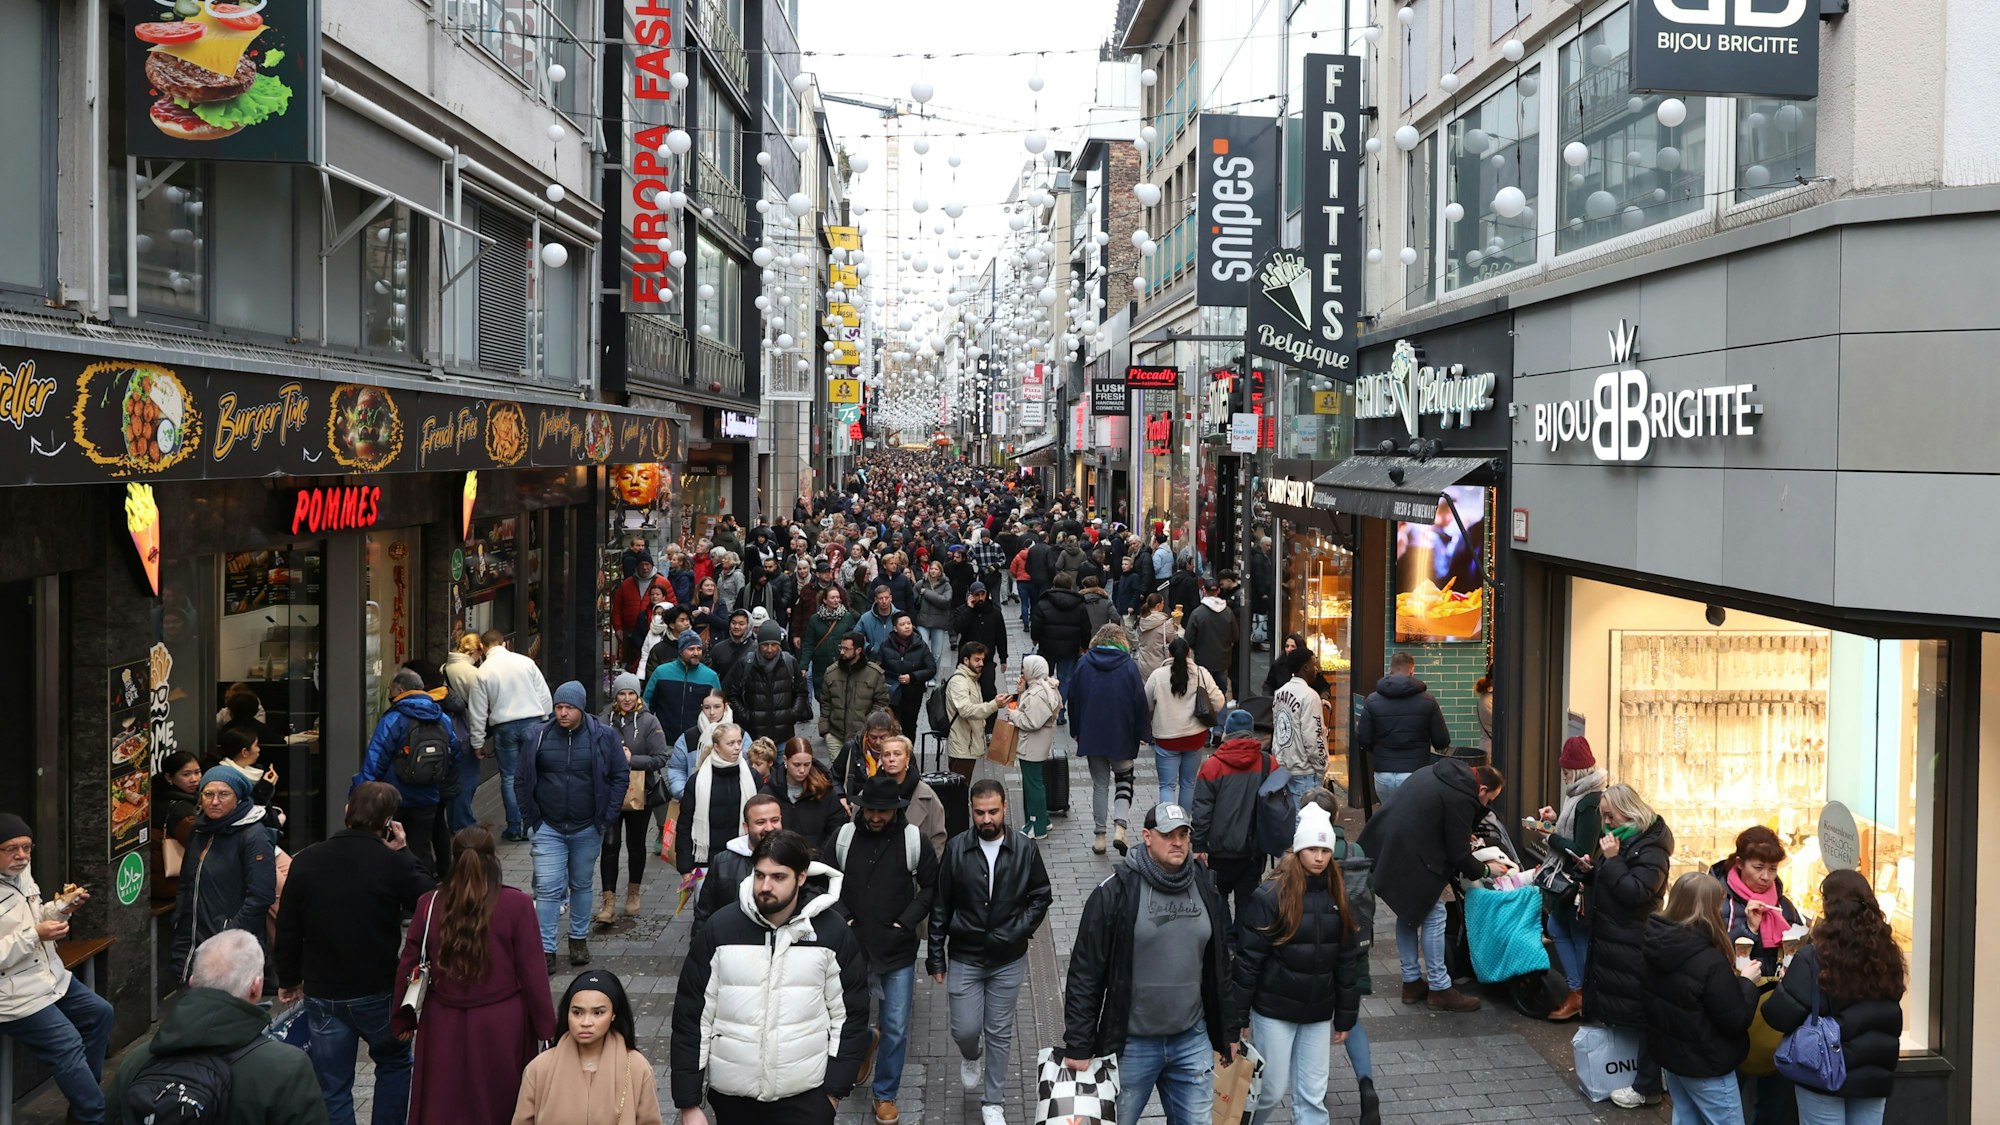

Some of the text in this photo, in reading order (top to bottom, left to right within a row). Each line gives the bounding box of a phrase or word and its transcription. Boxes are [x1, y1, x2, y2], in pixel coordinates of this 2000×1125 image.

[1657, 31, 1799, 54] BIJOU BRIGITTE
[632, 124, 671, 303] EUROPA
[1321, 63, 1348, 341] FRITES
[1211, 155, 1261, 282] snipes
[1258, 322, 1350, 371] Belgique
[1095, 384, 1125, 393] LUSH
[1128, 368, 1177, 382] Piccadly
[1095, 393, 1125, 401] FRESH
[1355, 364, 1496, 430] FRITES Belgique
[213, 381, 310, 462] Burger Time
[1535, 398, 1592, 452] BIJOU
[420, 406, 478, 469] French Fries
[1286, 480, 1304, 508] SHOP
[291, 485, 381, 535] POMMES
[1394, 501, 1408, 516] FRESH
[1823, 832, 1855, 853] OHRLOCH-
[1823, 843, 1852, 865] STECHEN
[119, 866, 142, 891] حلال
[120, 883, 140, 898] HALAL
